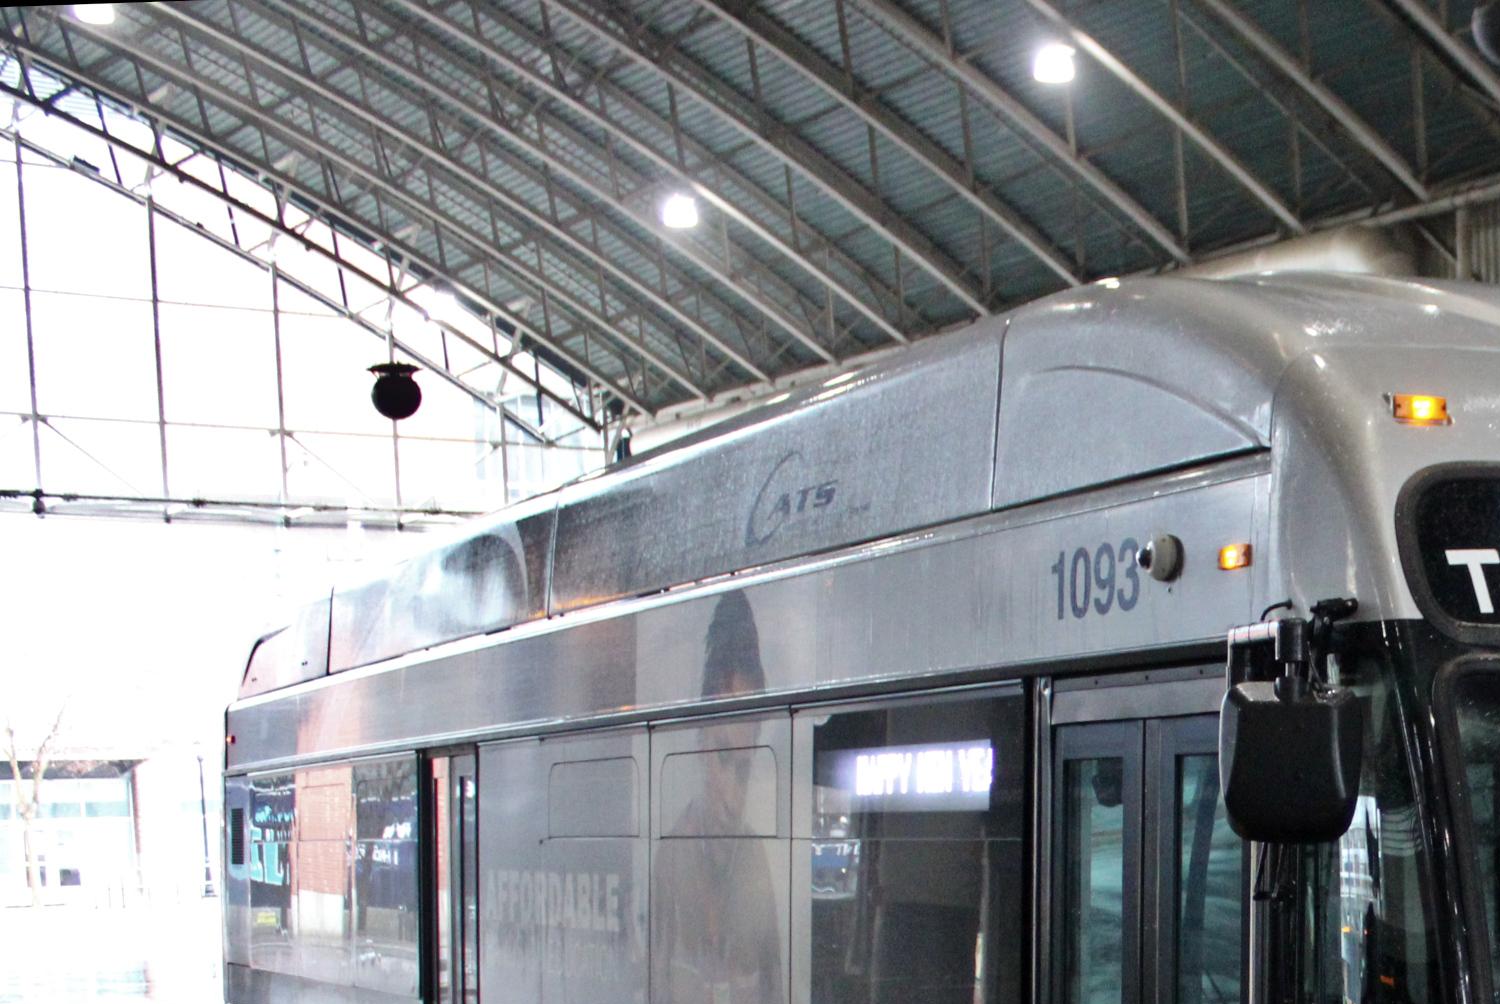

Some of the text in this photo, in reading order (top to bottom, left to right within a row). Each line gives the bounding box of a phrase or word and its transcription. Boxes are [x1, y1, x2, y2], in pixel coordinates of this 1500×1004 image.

[1050, 537, 1141, 622] 1093
[1446, 549, 1500, 613] T
[486, 869, 620, 932] AFFORDABLE
